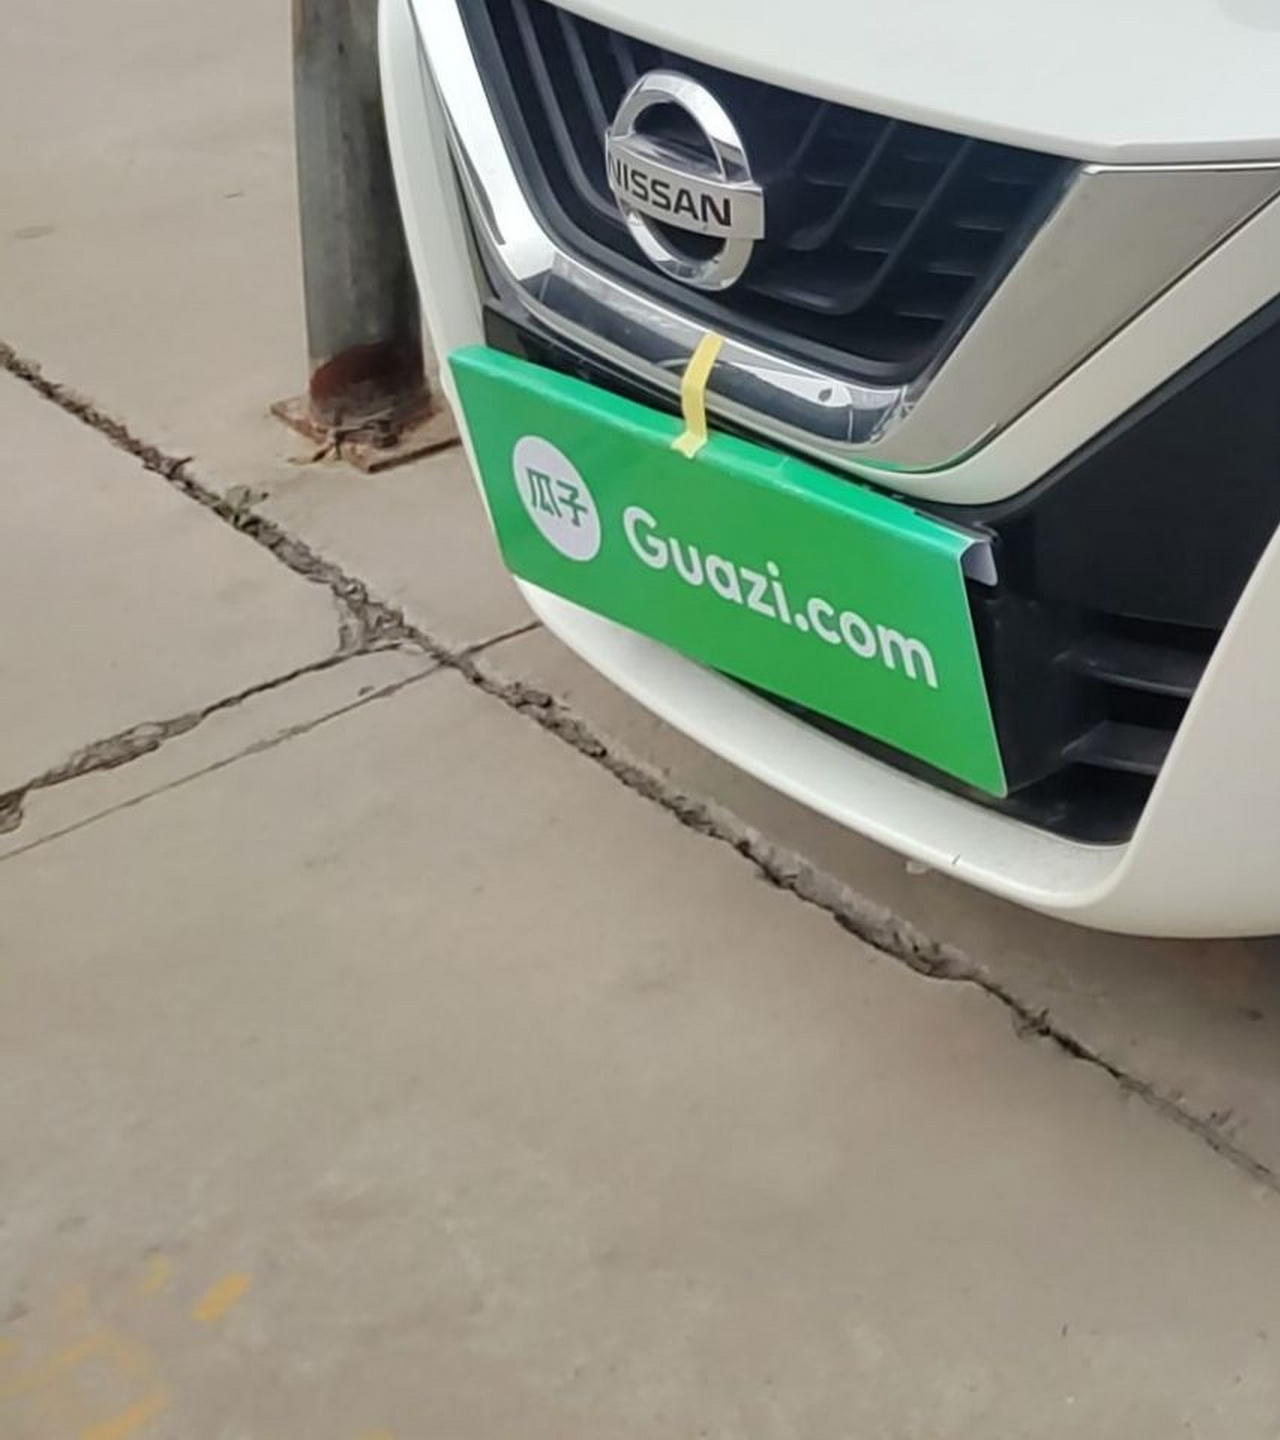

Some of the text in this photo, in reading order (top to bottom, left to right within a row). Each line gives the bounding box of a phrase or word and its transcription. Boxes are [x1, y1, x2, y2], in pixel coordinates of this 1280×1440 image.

[612, 159, 732, 227] NISSAN
[526, 467, 589, 527] 瓜子
[622, 506, 939, 689] Guazi.com
